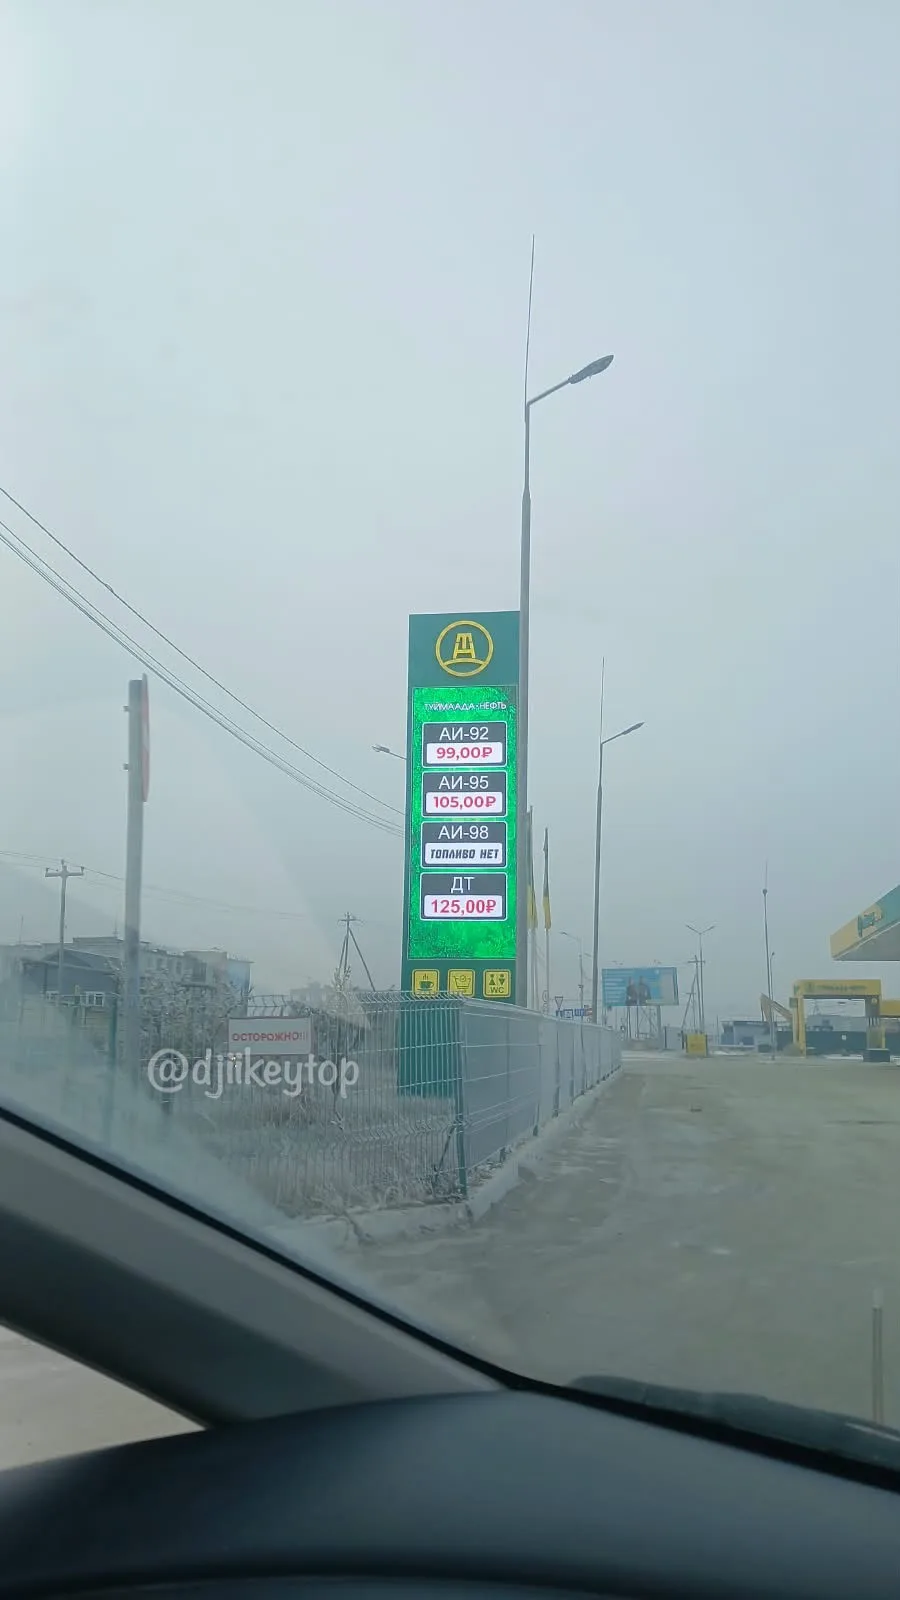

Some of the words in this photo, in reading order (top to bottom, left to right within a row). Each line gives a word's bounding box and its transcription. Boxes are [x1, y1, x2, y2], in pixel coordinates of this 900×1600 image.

[439, 726, 489, 741] АИ-92
[436, 747, 493, 760] 99,00₽
[438, 775, 489, 790] АИ-95
[433, 796, 497, 810] 105,00₽
[438, 825, 489, 840] АИ-98
[430, 849, 476, 859] ТОПЛИВО
[480, 849, 499, 859] НЕТ
[450, 876, 475, 894] ДТ
[431, 899, 497, 916] 125,00₽
[490, 986, 504, 994] WC
